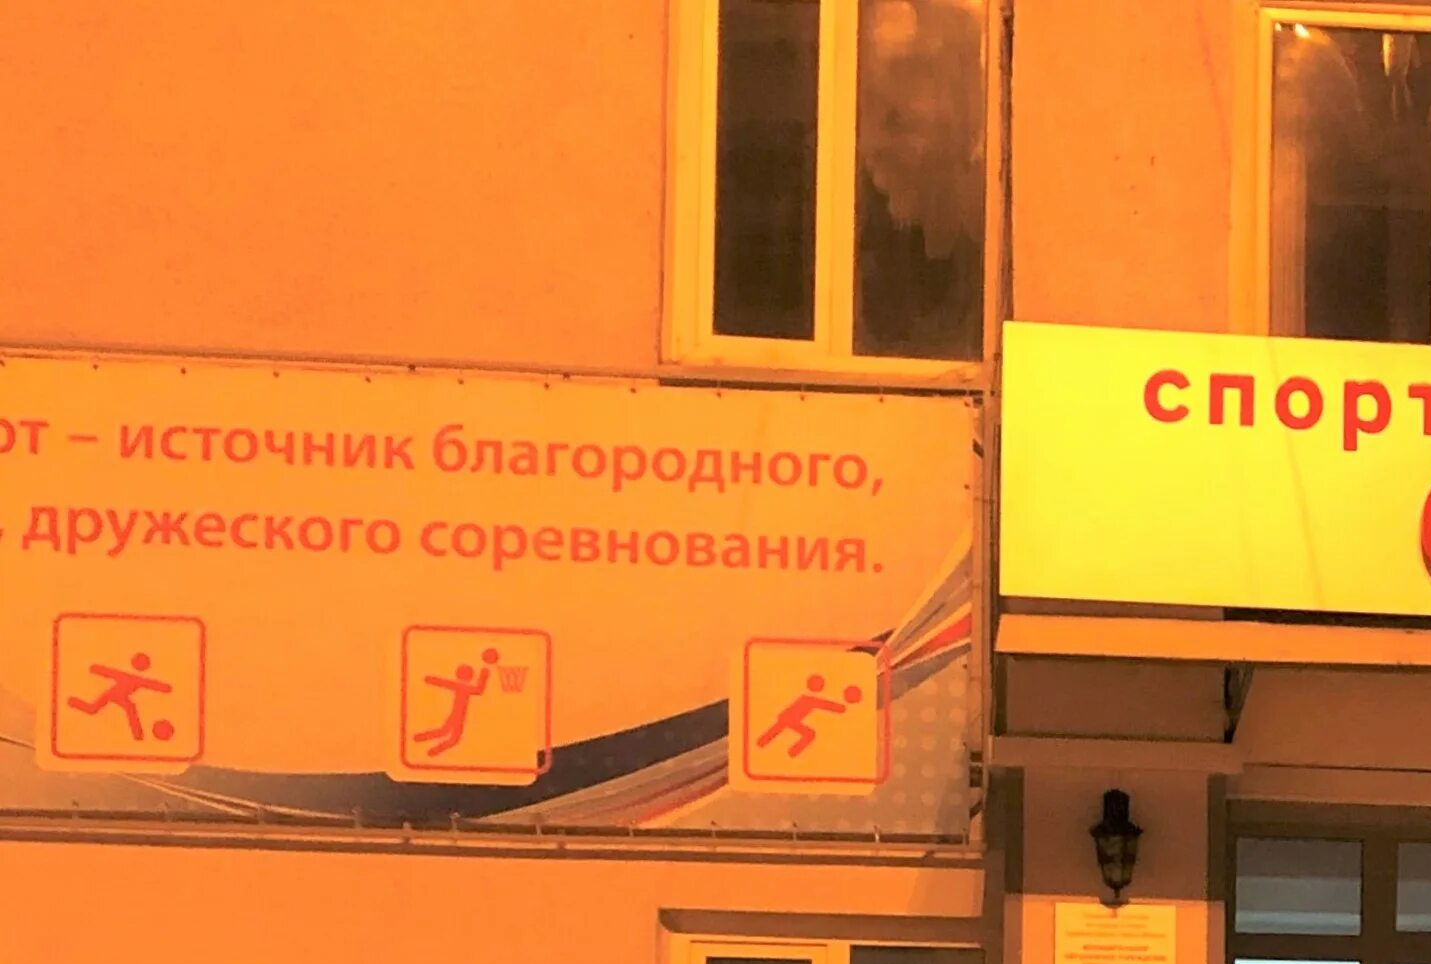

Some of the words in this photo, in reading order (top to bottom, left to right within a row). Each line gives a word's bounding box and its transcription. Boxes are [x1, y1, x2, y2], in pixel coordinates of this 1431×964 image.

[119, 424, 415, 470] источник
[432, 423, 883, 497] благородного,
[21, 506, 401, 558] дружеского
[419, 521, 884, 574] соревнования.
